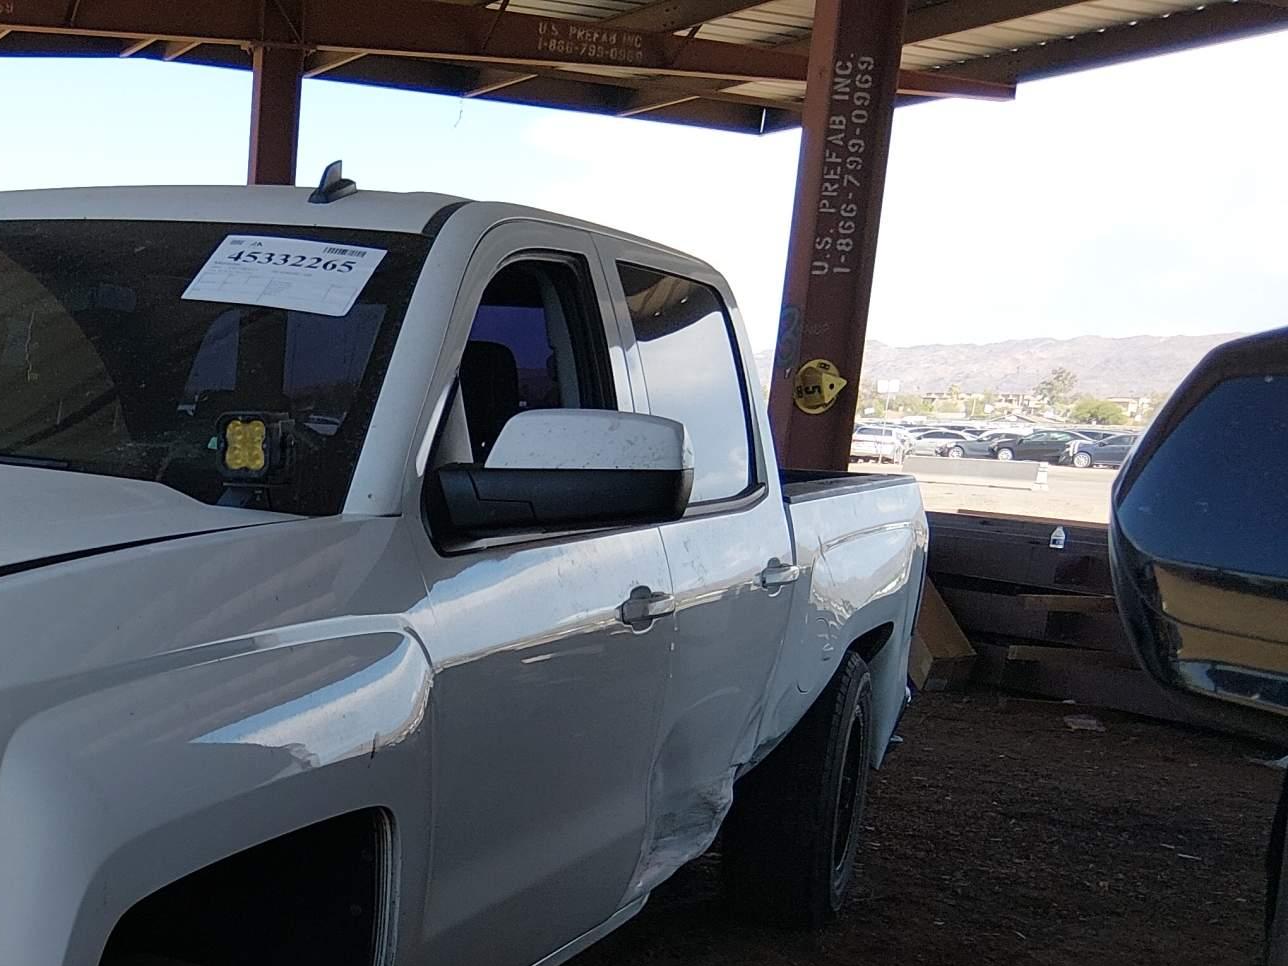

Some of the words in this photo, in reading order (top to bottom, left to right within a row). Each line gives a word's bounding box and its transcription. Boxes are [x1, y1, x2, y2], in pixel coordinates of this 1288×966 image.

[832, 53, 855, 100] INC.
[819, 114, 847, 213] PREFAB
[833, 56, 874, 274] 1-866-799-0969
[227, 250, 357, 273] 45332265
[811, 228, 834, 275] U.S.
